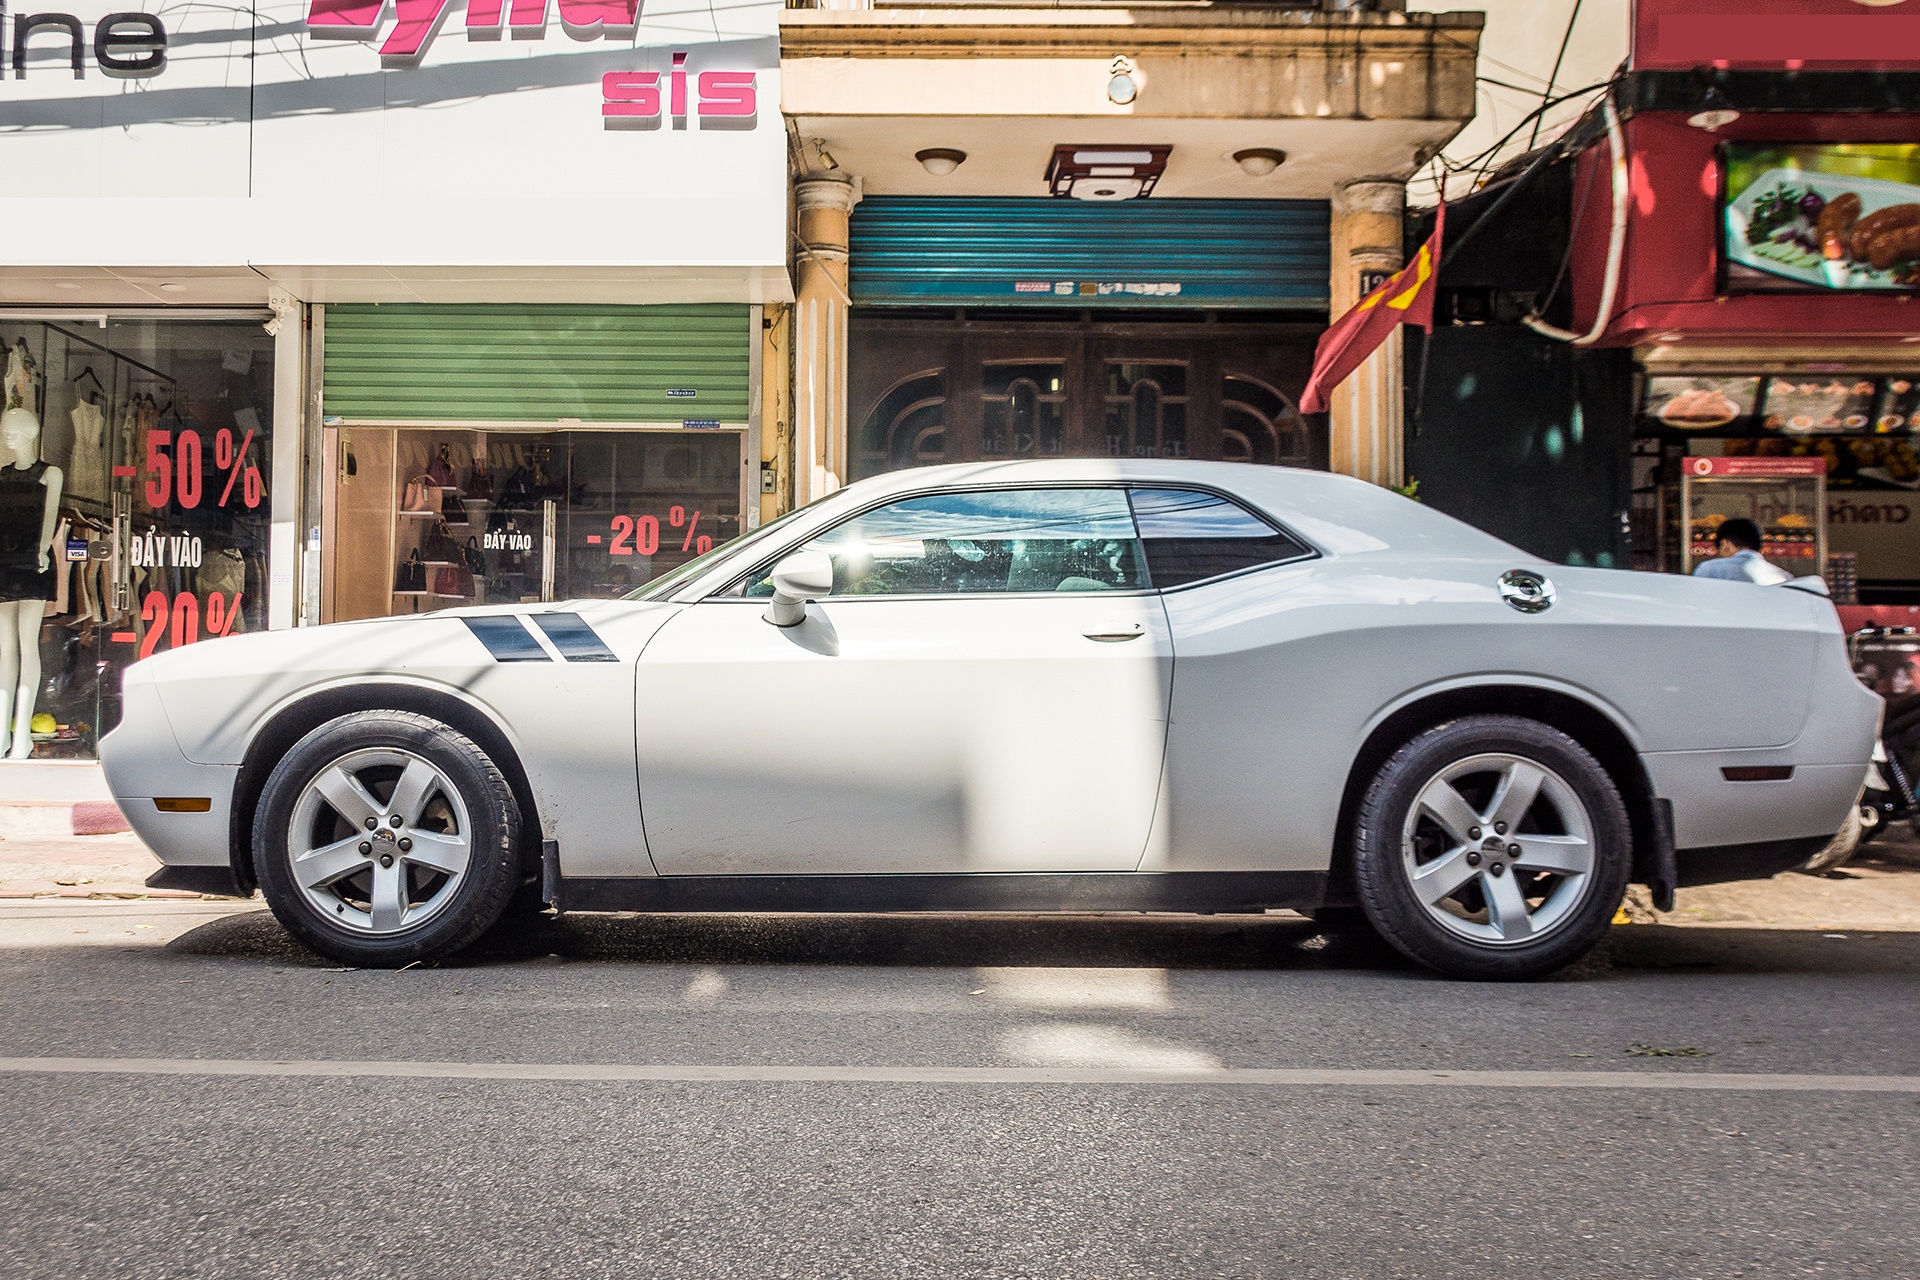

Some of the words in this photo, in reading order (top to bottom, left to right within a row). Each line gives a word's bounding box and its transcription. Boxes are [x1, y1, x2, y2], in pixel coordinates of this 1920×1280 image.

[602, 52, 758, 122] sis
[131, 525, 166, 567] ĐẨY
[171, 530, 202, 568] VÀO
[484, 528, 506, 550] ĐẨY
[509, 530, 531, 550] VÀO
